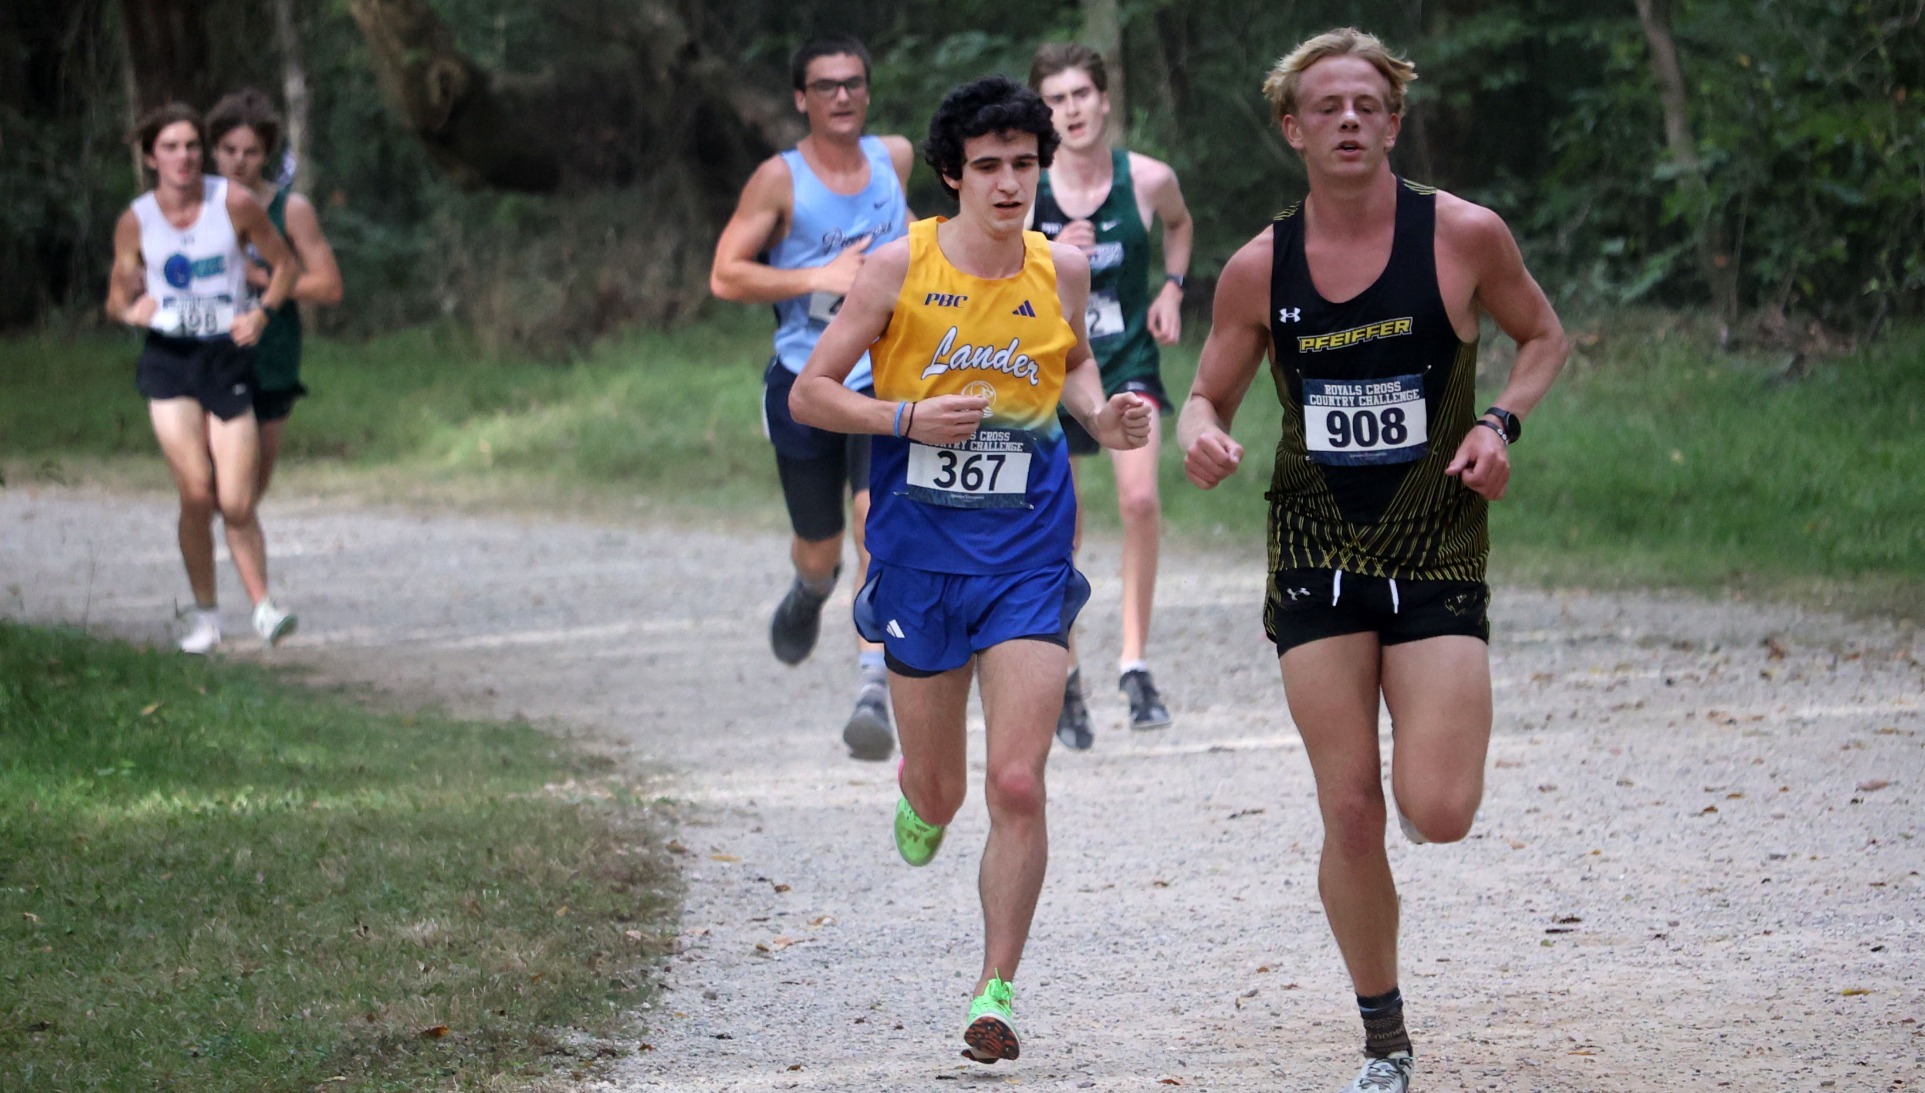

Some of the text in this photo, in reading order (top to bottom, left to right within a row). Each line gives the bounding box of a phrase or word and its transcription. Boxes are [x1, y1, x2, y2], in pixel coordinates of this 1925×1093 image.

[924, 292, 969, 308] PBC
[1297, 317, 1414, 354] PFEIFFER
[920, 325, 1040, 387] Lander
[1309, 388, 1420, 407] COUNTRY CHALLENGE
[1324, 381, 1402, 396] ROYALS CROSS
[979, 430, 1011, 442] CROSS
[1326, 407, 1408, 448] 908
[969, 441, 1024, 452] CHALLENGE
[933, 450, 1006, 491] 367
